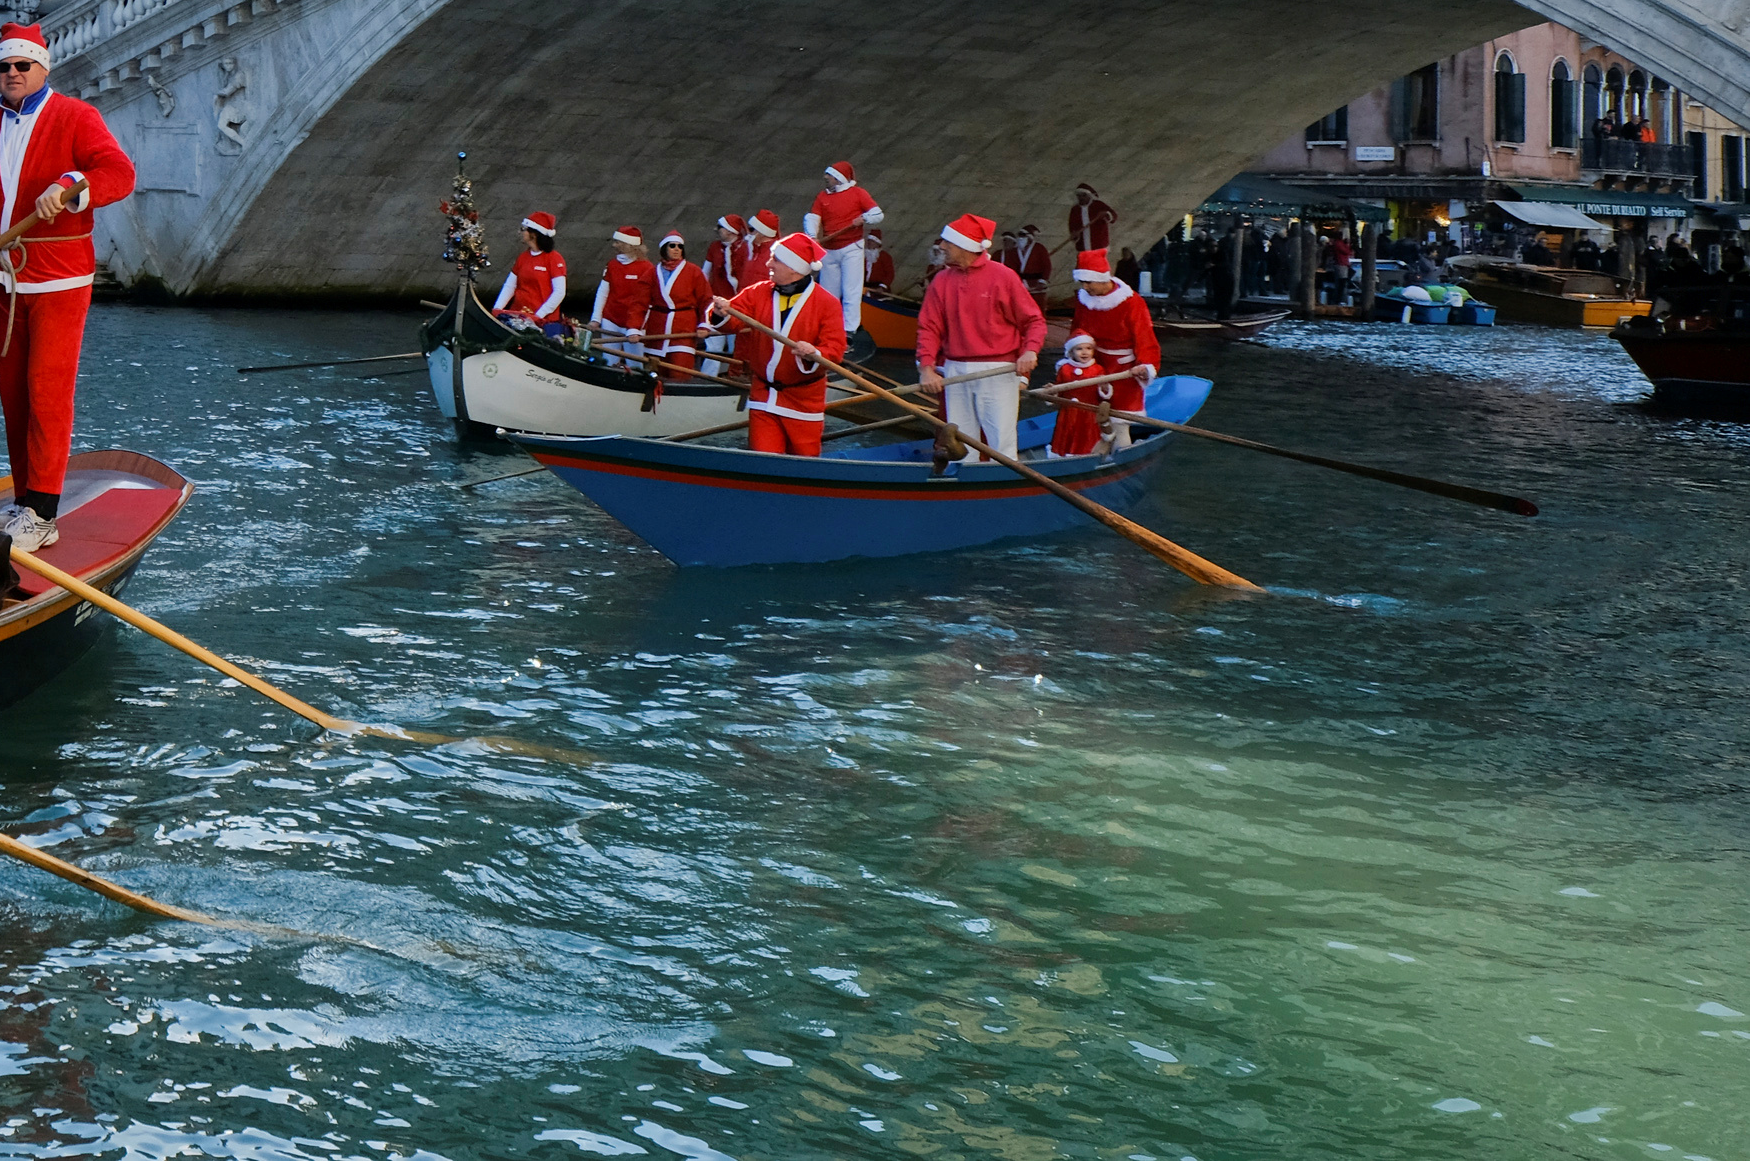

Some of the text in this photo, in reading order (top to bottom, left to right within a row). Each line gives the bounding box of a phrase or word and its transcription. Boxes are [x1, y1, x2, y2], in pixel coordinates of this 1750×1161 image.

[1587, 203, 1611, 215] PONTE
[1612, 205, 1621, 215] DI
[1621, 205, 1646, 216] RIALTO
[1650, 206, 1664, 217] Self
[1664, 206, 1687, 218] Service
